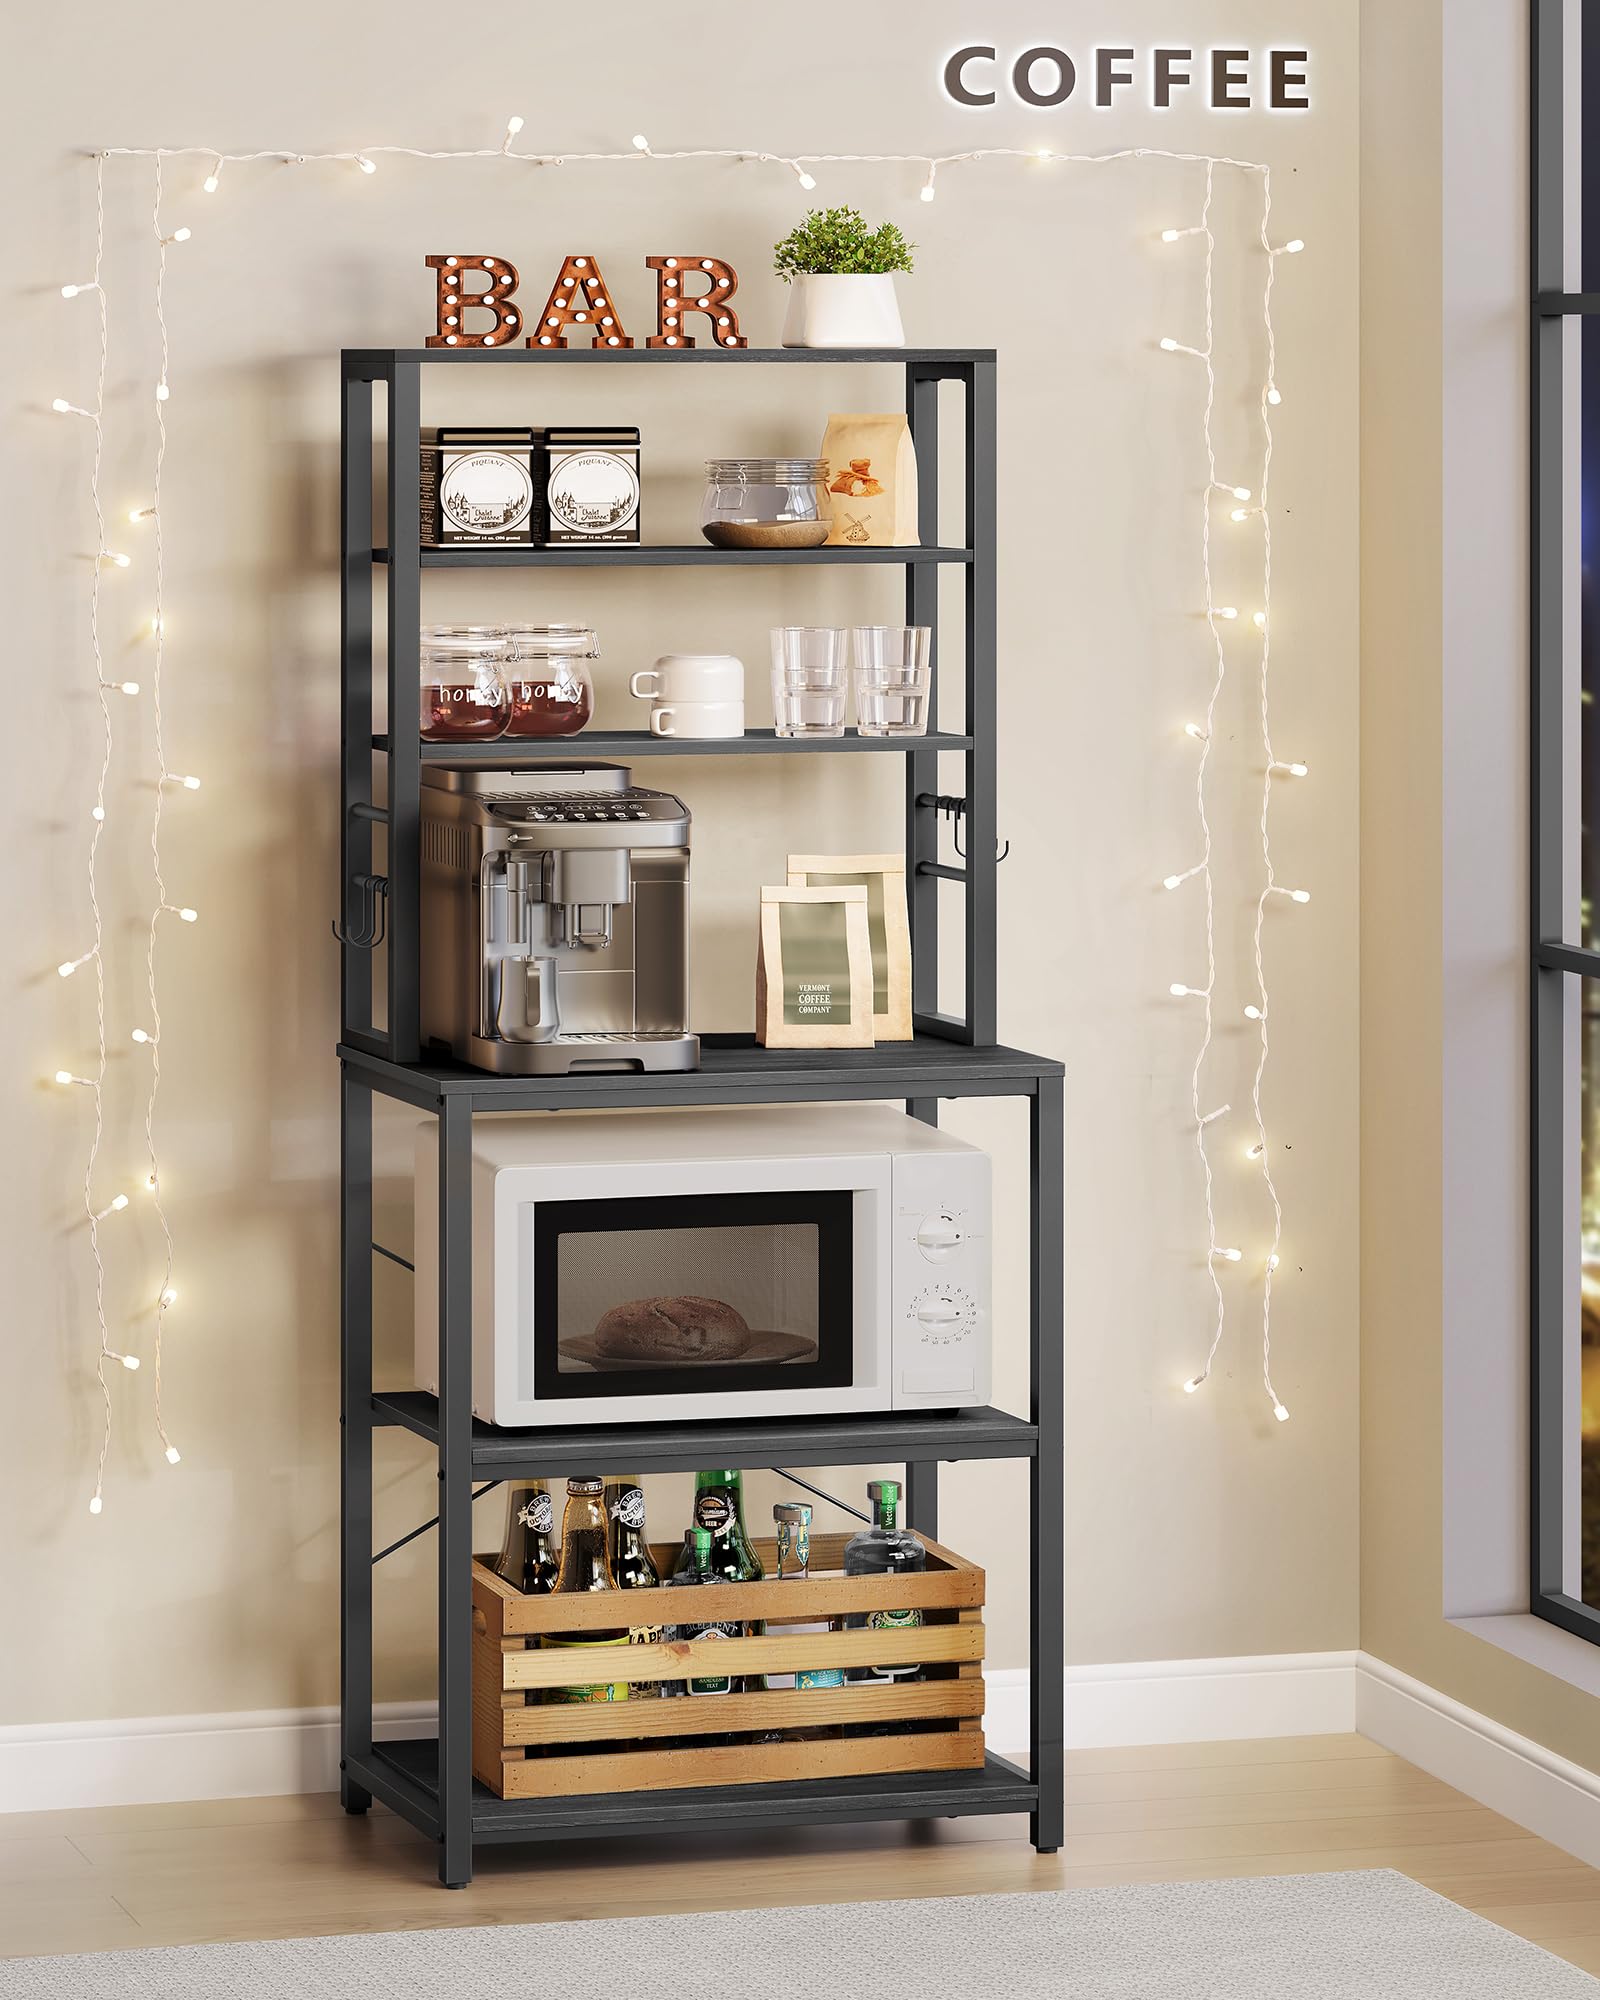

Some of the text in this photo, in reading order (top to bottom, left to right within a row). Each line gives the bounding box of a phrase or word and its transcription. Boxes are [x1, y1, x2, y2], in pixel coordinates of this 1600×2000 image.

[943, 45, 1309, 109] COFFEE
[425, 255, 748, 349] BAR
[471, 459, 505, 467] PIQUANT
[578, 458, 612, 466] PIQUANT
[799, 984, 831, 992] VERMONT
[798, 994, 831, 1004] COFFEE
